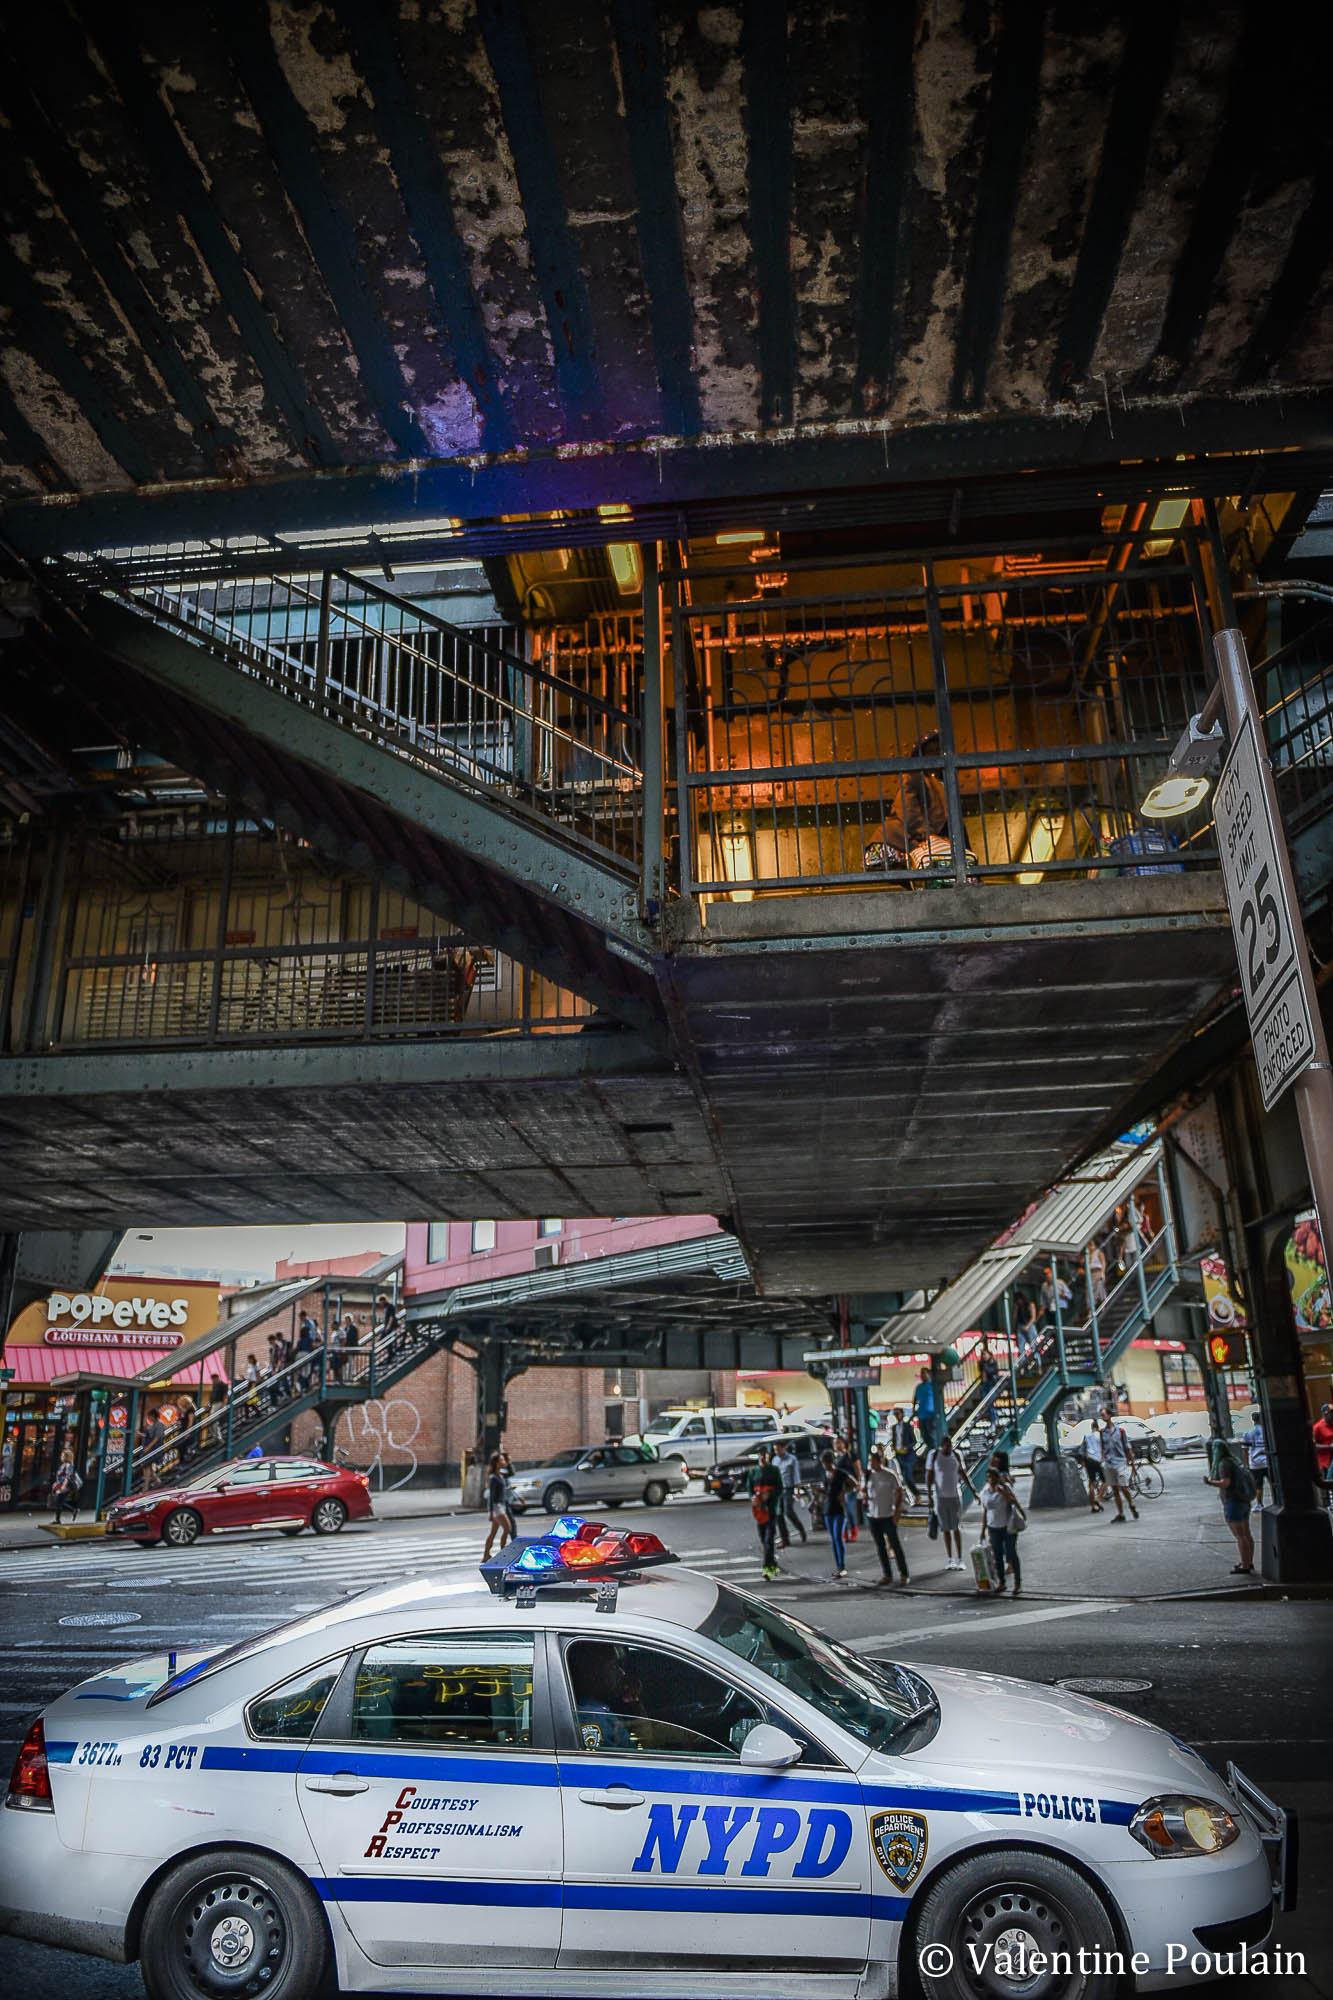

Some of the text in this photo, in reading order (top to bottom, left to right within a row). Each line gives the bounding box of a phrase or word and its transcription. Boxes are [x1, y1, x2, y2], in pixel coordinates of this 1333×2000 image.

[1224, 760, 1241, 816] CITY
[1227, 791, 1252, 858] SPEED
[1235, 829, 1257, 890] LIMIT
[1240, 861, 1281, 997] 25
[1263, 1001, 1290, 1046] PHOTO
[1263, 1021, 1305, 1090] ENFORCED
[53, 1331, 179, 1345] LOUISIANA KITCHEN
[78, 1742, 118, 1765] 3677
[140, 1744, 198, 1769] 83 PCT
[395, 1787, 479, 1811] COURTESY
[1023, 1793, 1097, 1823] POLICE
[379, 1811, 523, 1837] PROFESSIONALISM
[874, 1823, 925, 1838] DEPARTMENT
[884, 1815, 914, 1825] POLICE
[364, 1835, 441, 1860] RESPECT
[632, 1804, 853, 1878] NYPD
[876, 1846, 897, 1878] CITY OF
[906, 1842, 926, 1882] NEW YORK
